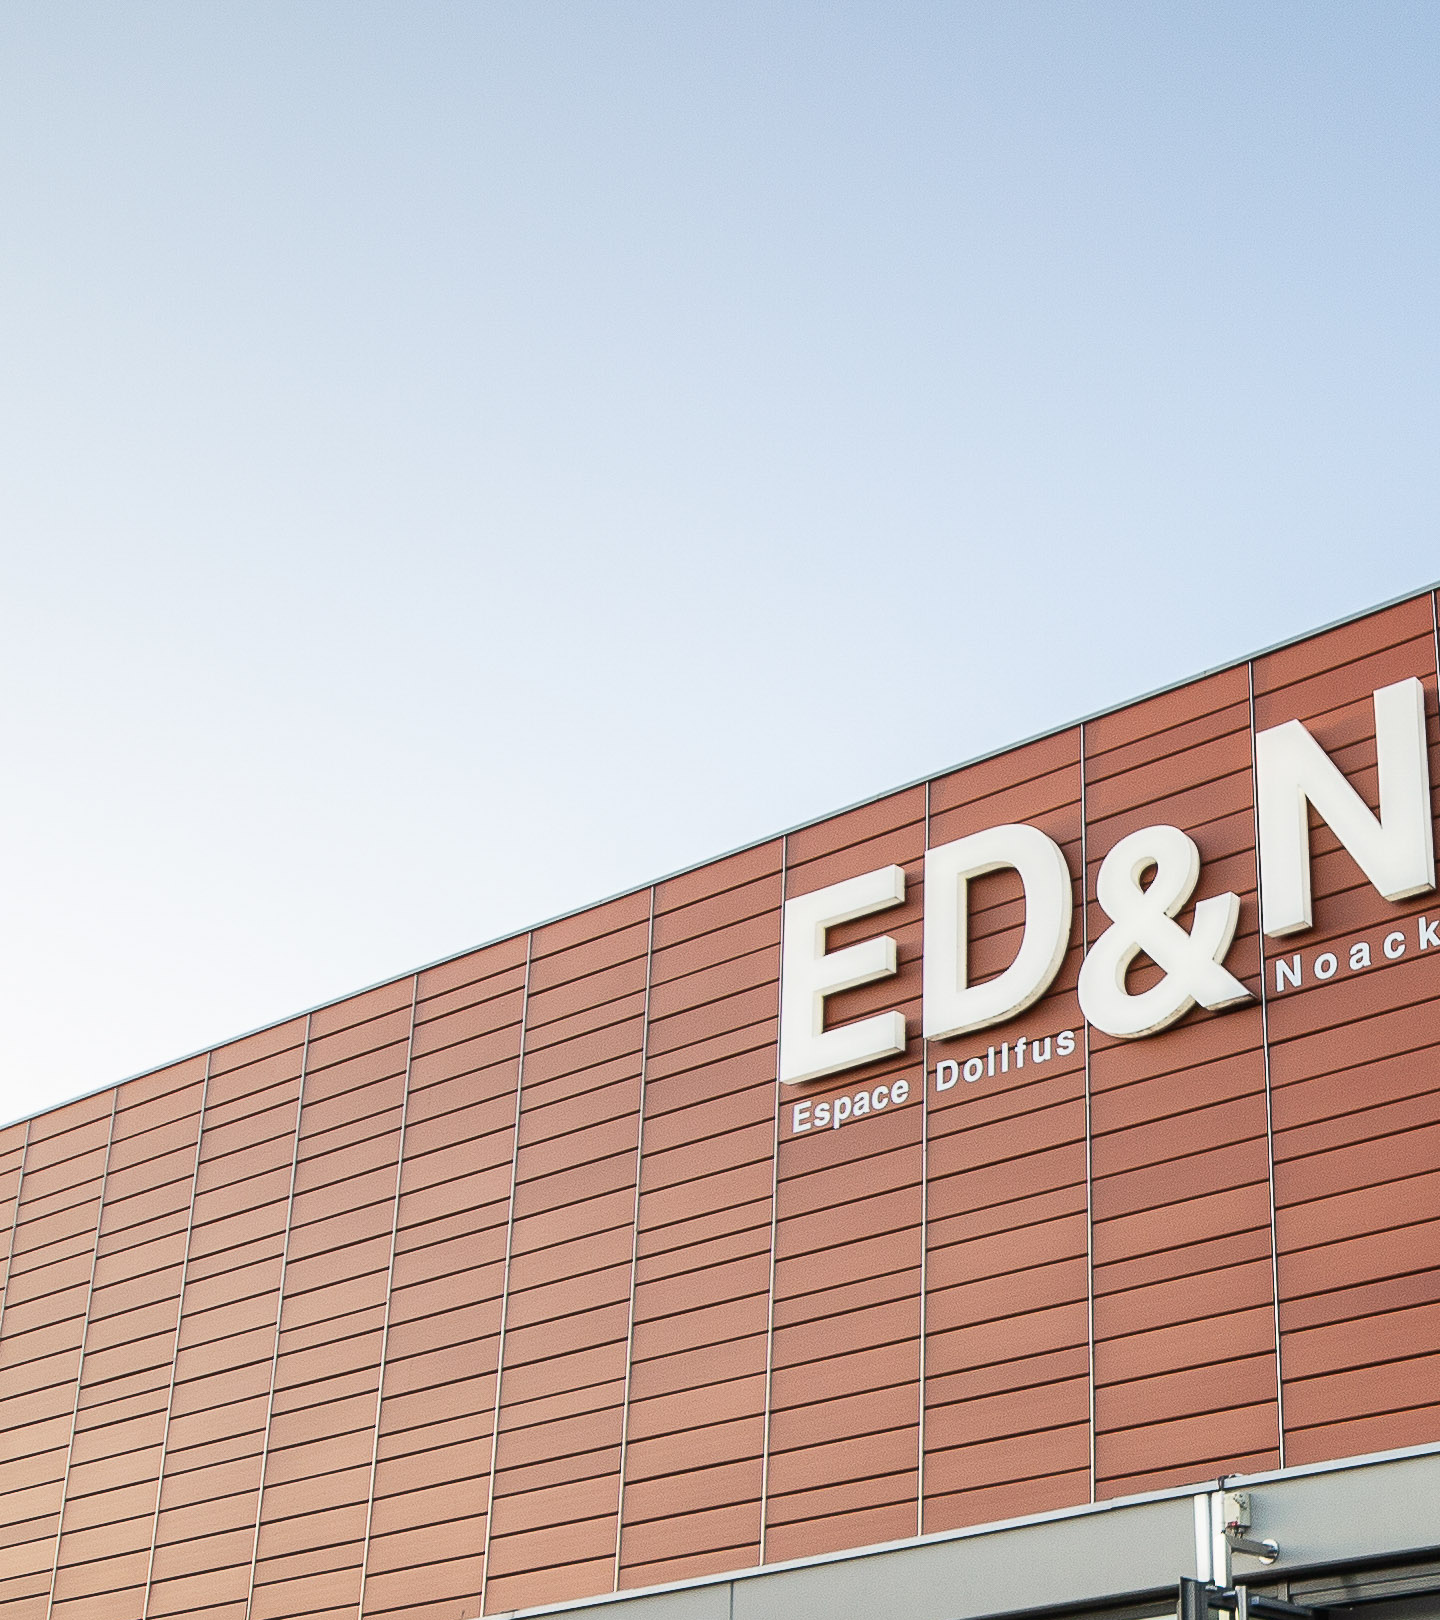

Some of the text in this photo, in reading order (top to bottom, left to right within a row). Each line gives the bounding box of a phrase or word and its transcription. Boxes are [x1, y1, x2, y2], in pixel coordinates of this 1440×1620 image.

[780, 676, 1436, 1085] ED&N
[792, 1078, 909, 1132] Espace
[935, 1028, 1076, 1092] Dollfus
